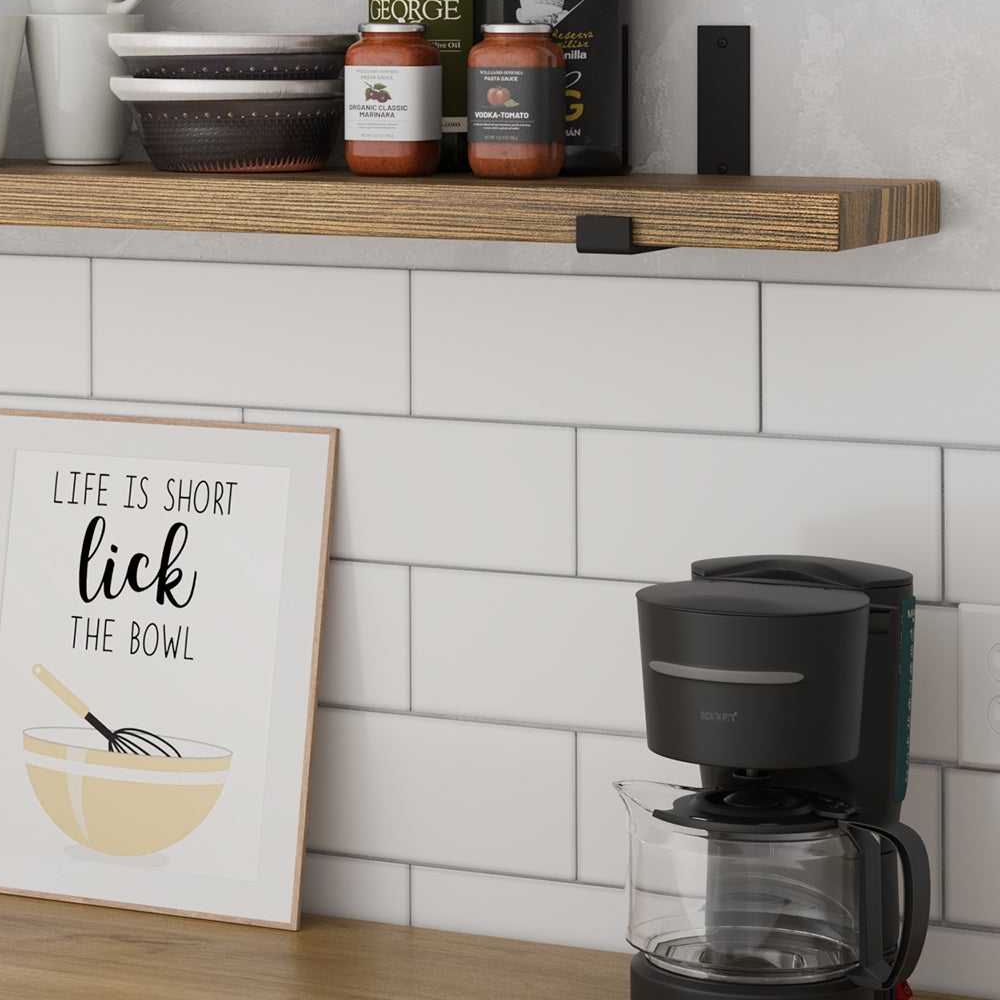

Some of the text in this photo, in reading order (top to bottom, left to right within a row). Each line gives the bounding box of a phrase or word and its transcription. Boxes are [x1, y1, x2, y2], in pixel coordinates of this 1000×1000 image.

[448, 41, 461, 49] Oil
[378, 104, 409, 112] CLASSIC
[359, 111, 395, 119] MARINARA
[474, 111, 530, 119] VODKA-TOMATO
[53, 470, 238, 516] LIFE IS SHORT
[78, 515, 198, 609] lick
[70, 615, 194, 661] THE BOWL
